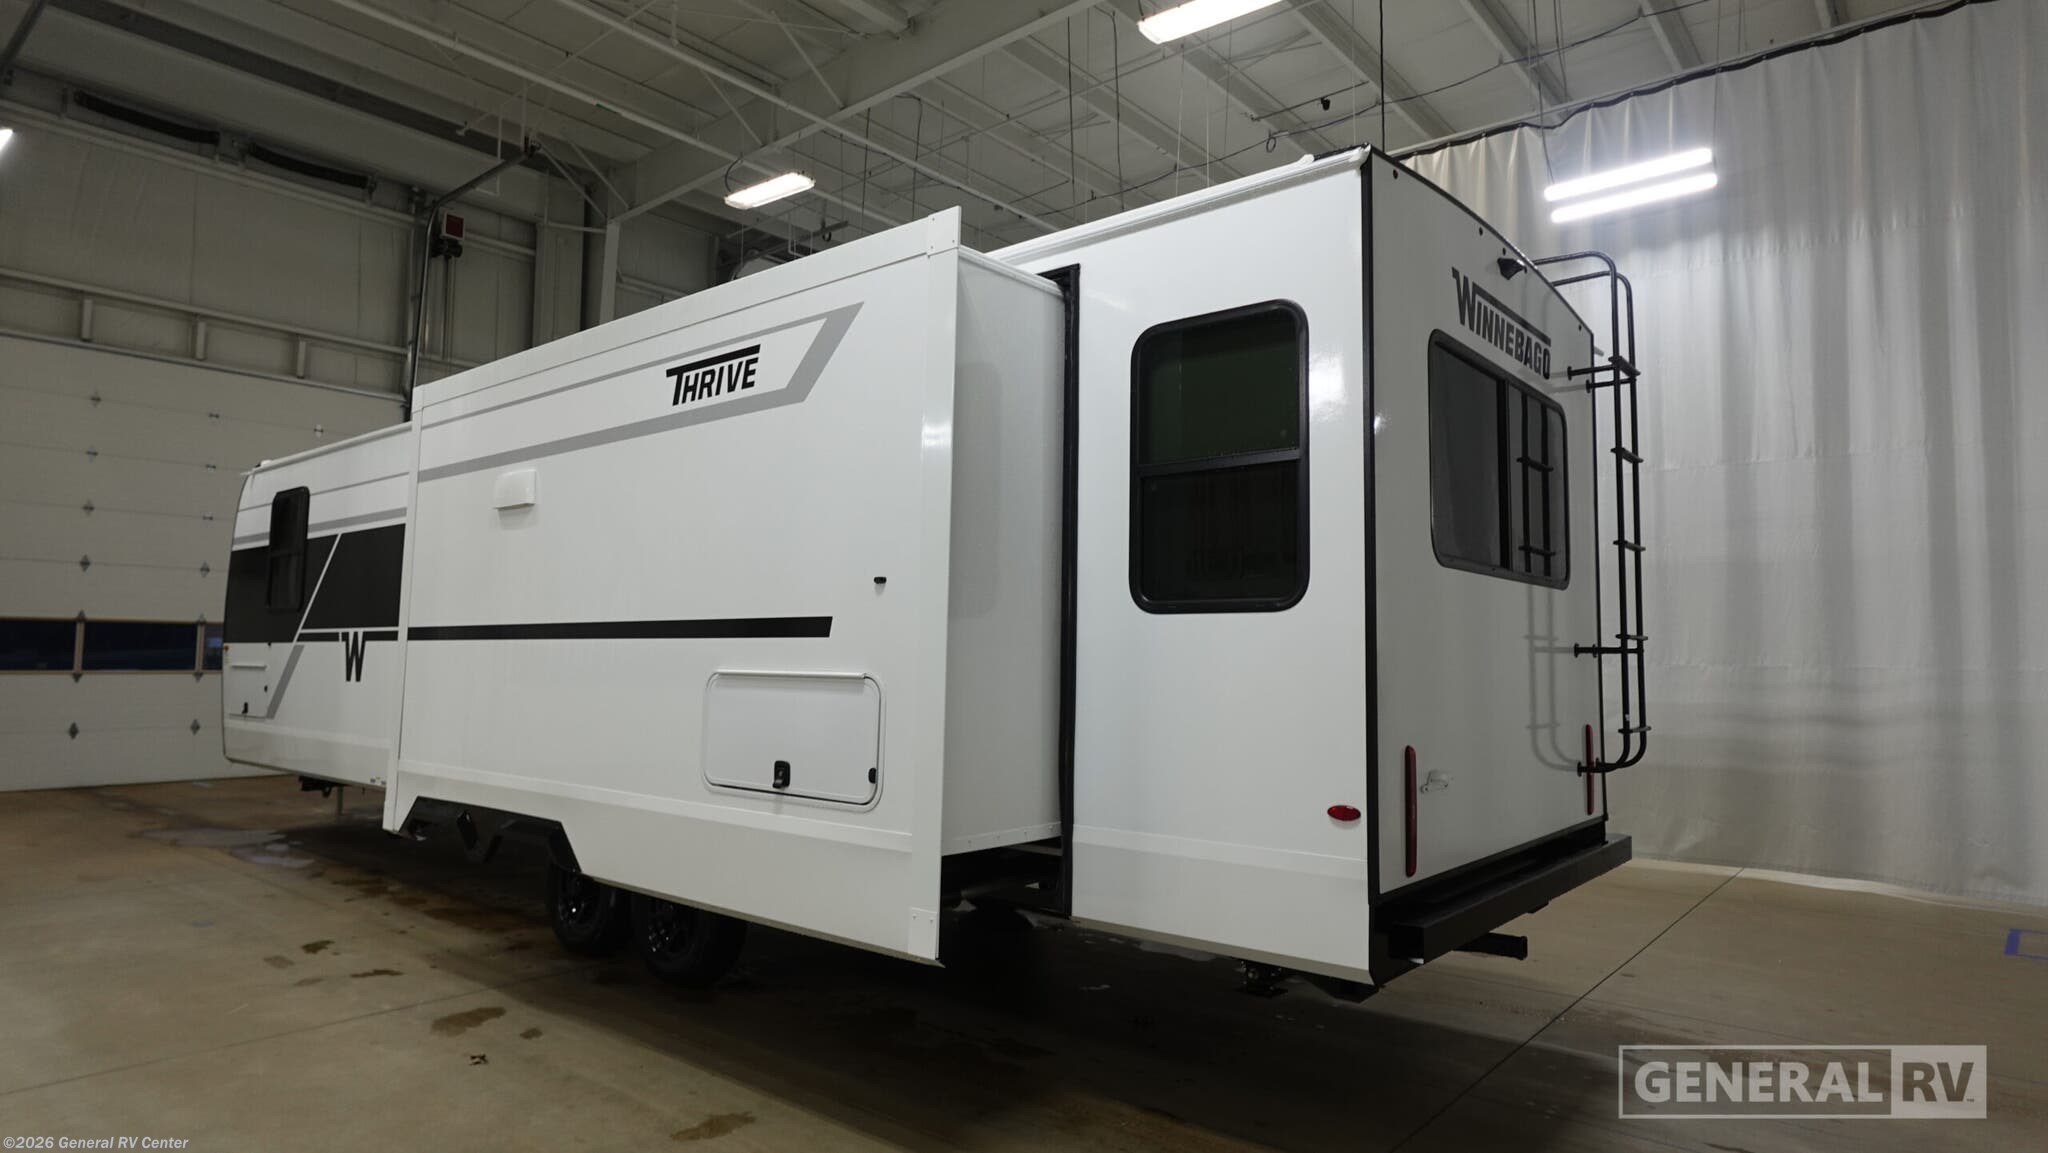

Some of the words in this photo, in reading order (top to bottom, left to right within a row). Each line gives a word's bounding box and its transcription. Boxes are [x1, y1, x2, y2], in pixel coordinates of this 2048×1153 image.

[1451, 266, 1552, 380] WINNEBAGO
[666, 343, 761, 406] THRIVE
[341, 631, 366, 682] W
